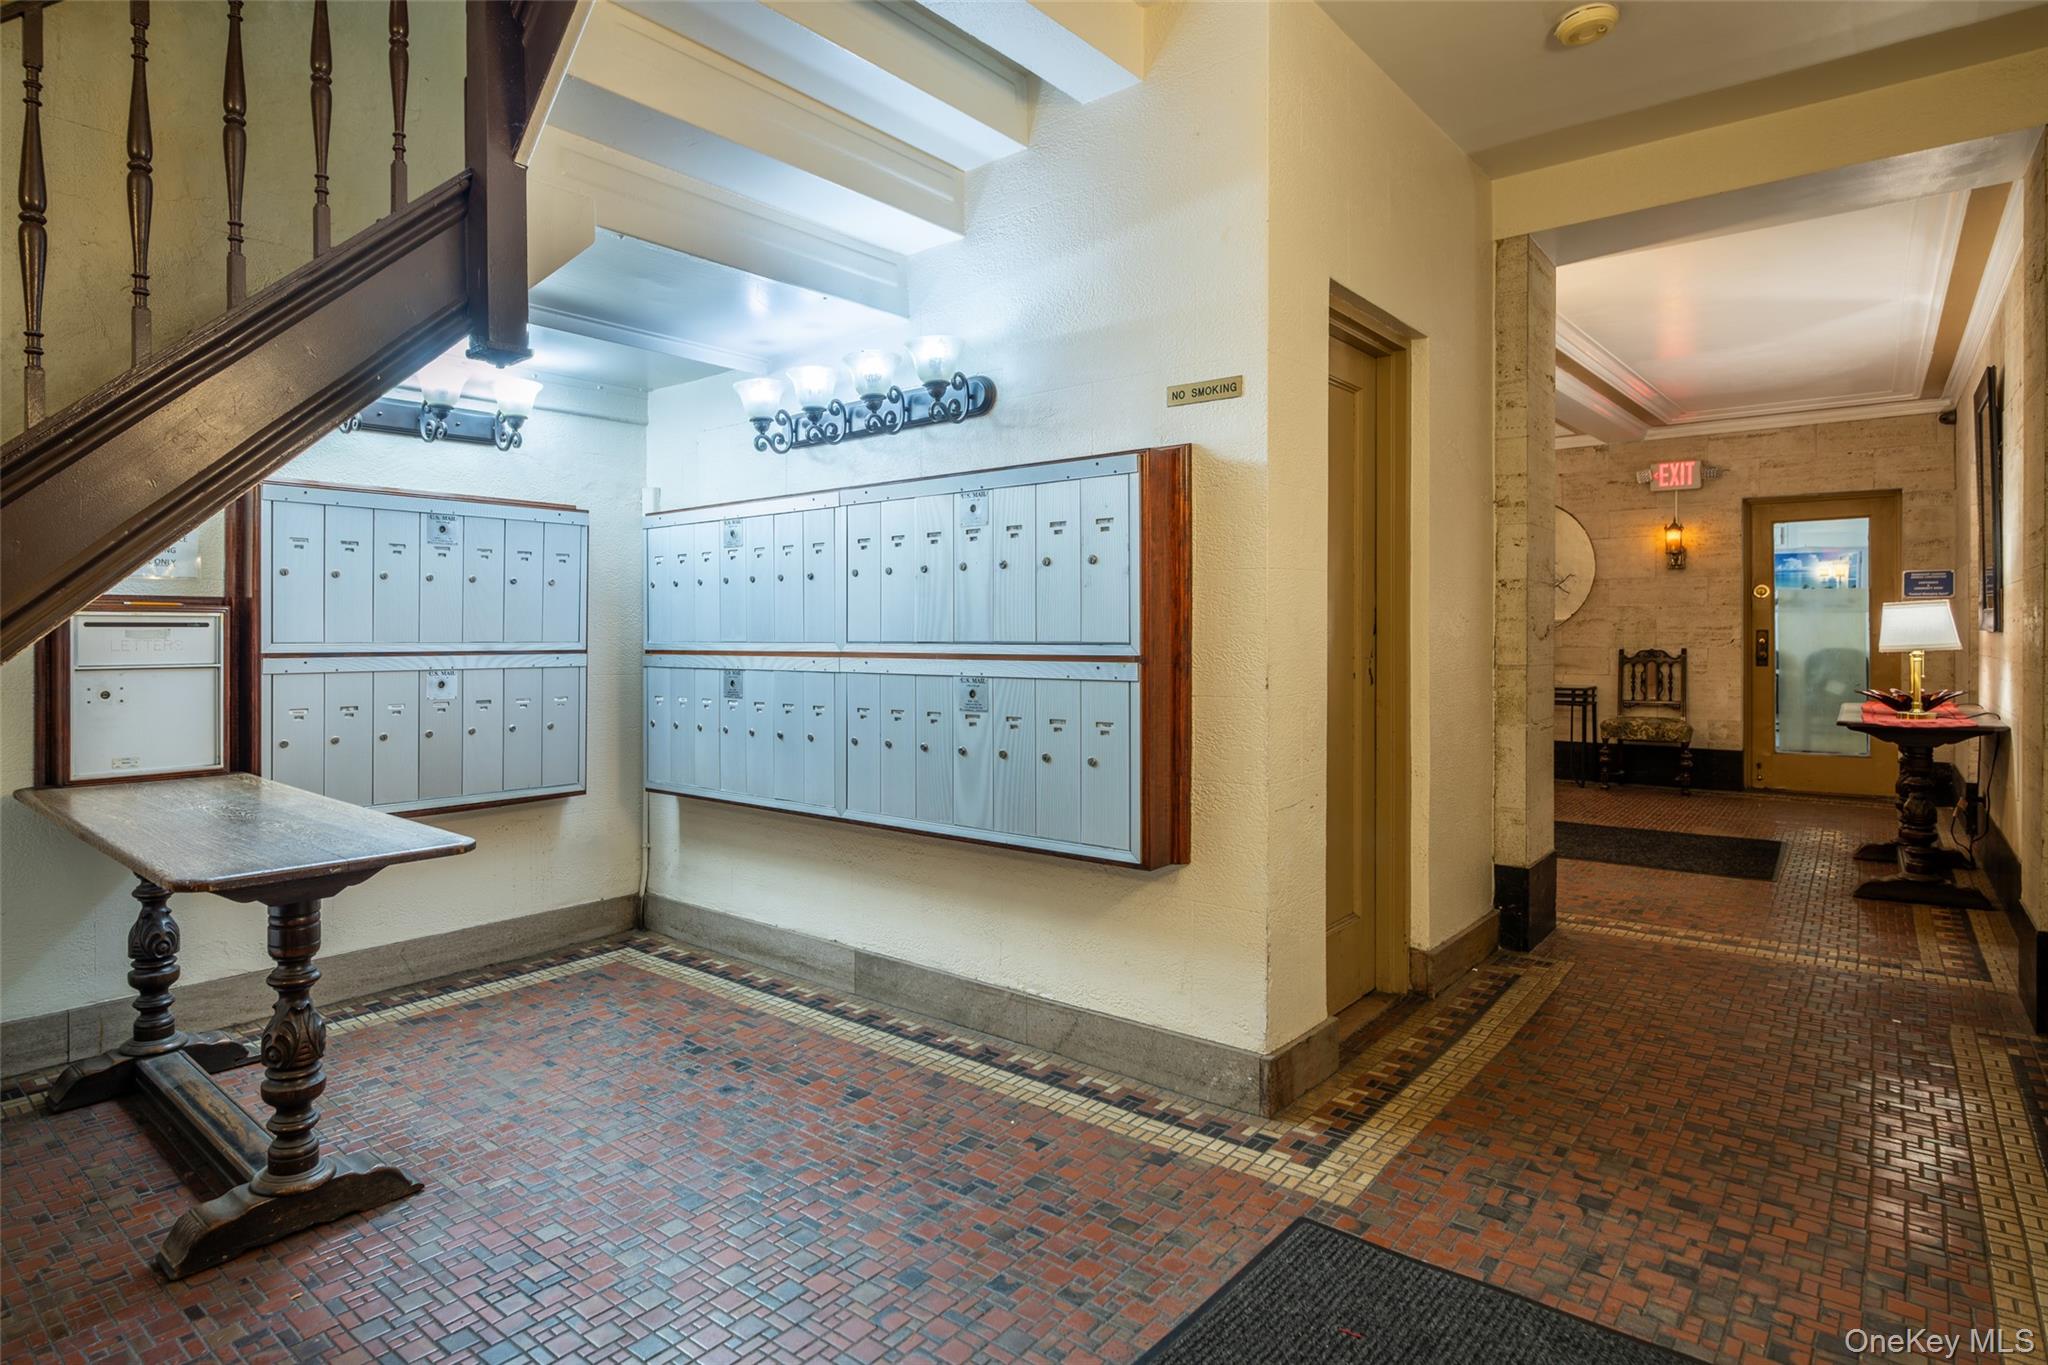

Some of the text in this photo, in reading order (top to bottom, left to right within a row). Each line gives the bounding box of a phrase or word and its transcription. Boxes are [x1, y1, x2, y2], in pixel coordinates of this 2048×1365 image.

[1172, 382, 1237, 401] NO SMOKING
[1658, 461, 1696, 487] EXIT
[110, 639, 184, 652] LETTERS
